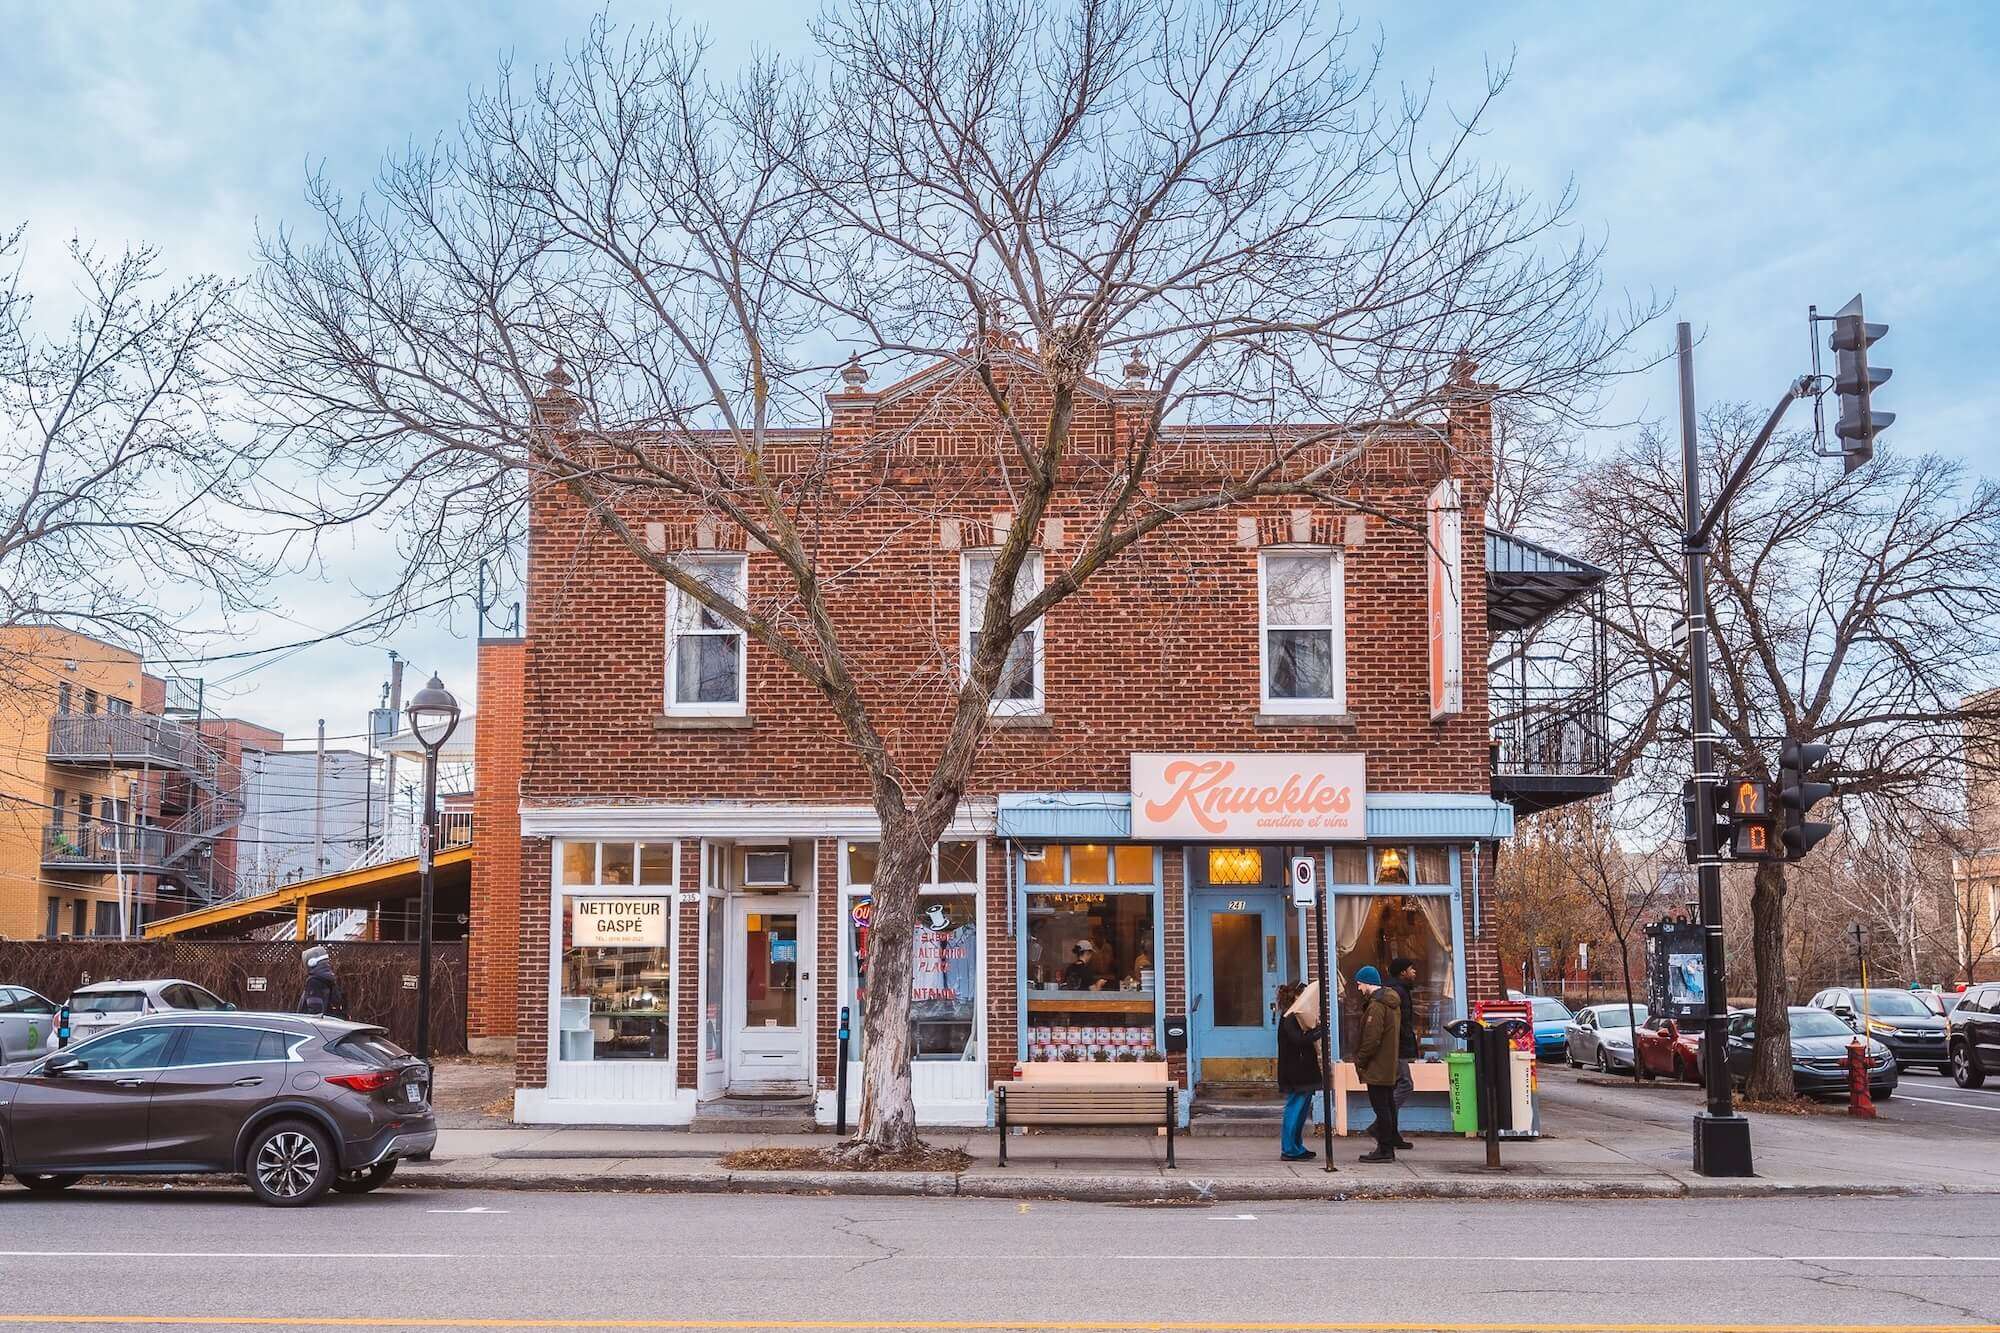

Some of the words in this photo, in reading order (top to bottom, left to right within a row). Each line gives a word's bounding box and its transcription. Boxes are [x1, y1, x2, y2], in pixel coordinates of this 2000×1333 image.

[1145, 761, 1351, 834] Knuckles
[1256, 815, 1304, 828] cantine
[1308, 815, 1321, 828] et
[1323, 815, 1348, 828] vins
[580, 902, 660, 915] NETTOYEUR
[1228, 900, 1246, 911] 241
[597, 917, 643, 932] GASPÉ
